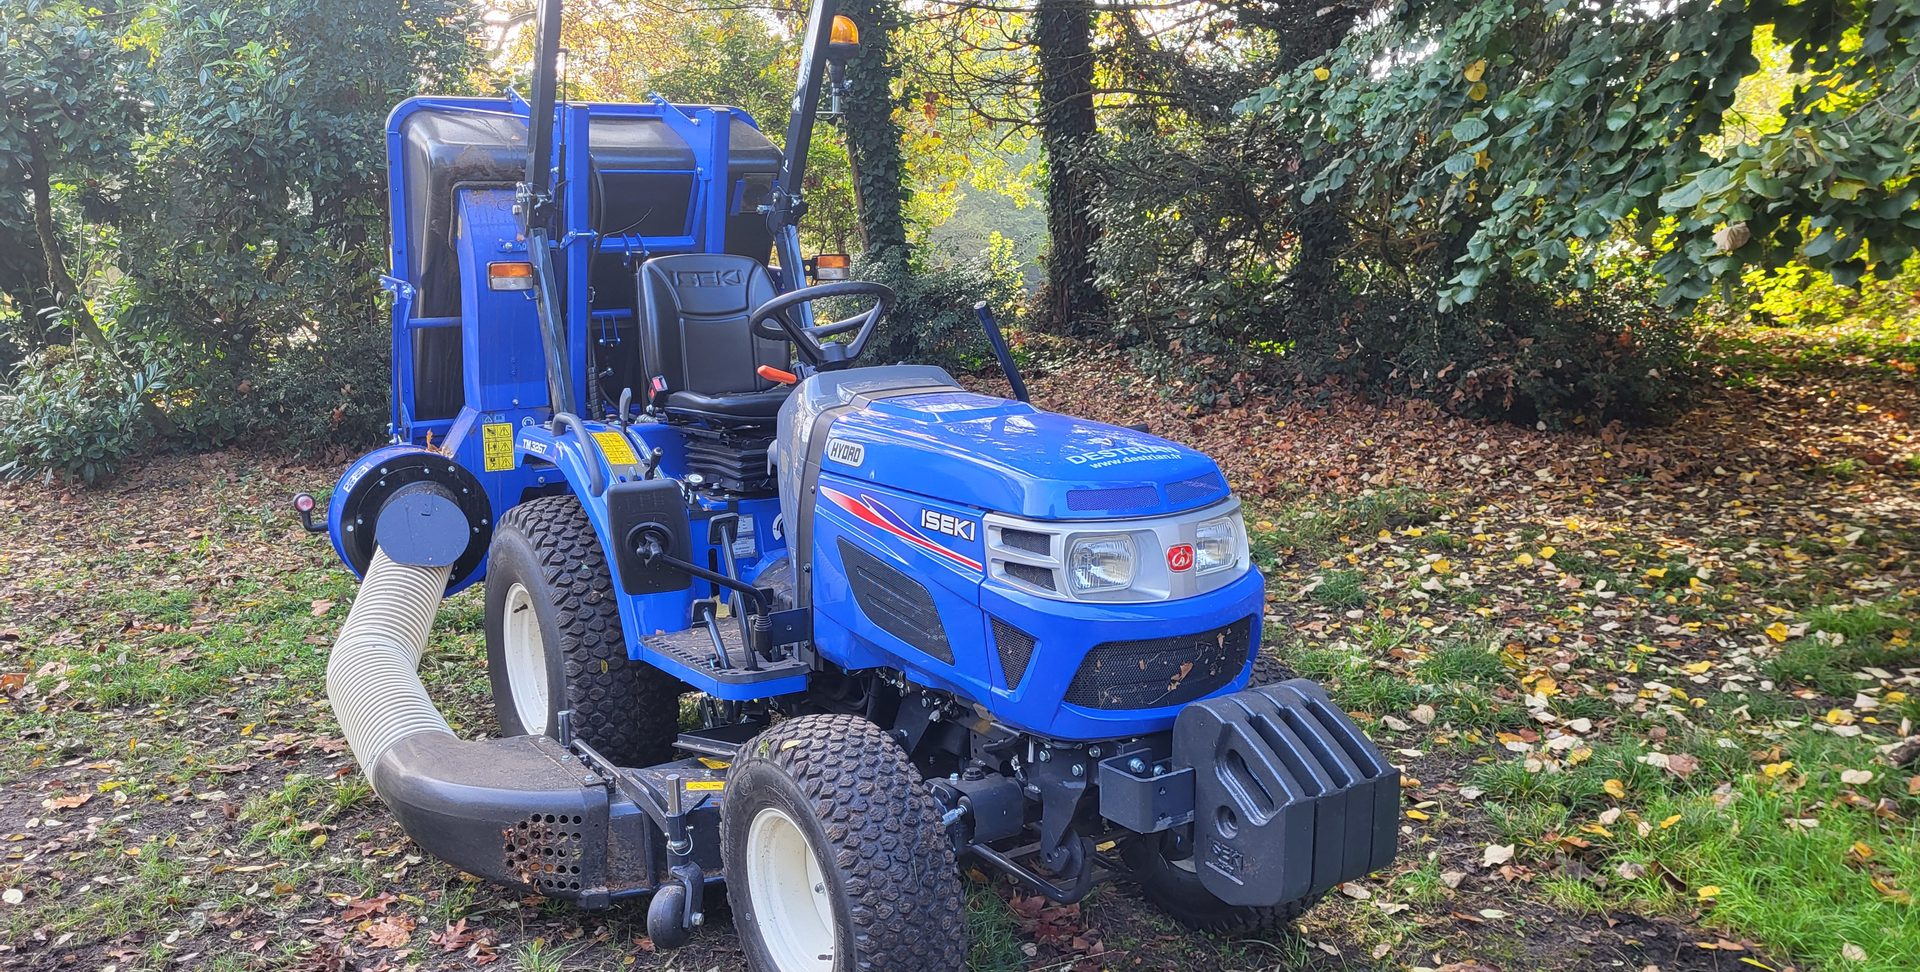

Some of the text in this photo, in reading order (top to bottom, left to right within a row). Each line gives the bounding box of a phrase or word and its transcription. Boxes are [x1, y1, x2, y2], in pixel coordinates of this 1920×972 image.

[671, 269, 745, 287] ISEKI
[830, 442, 861, 463] HYDRO
[1065, 446, 1181, 465] DESTRIAN
[1089, 453, 1182, 469] www.destrian.fr
[921, 508, 975, 542] ISEKI
